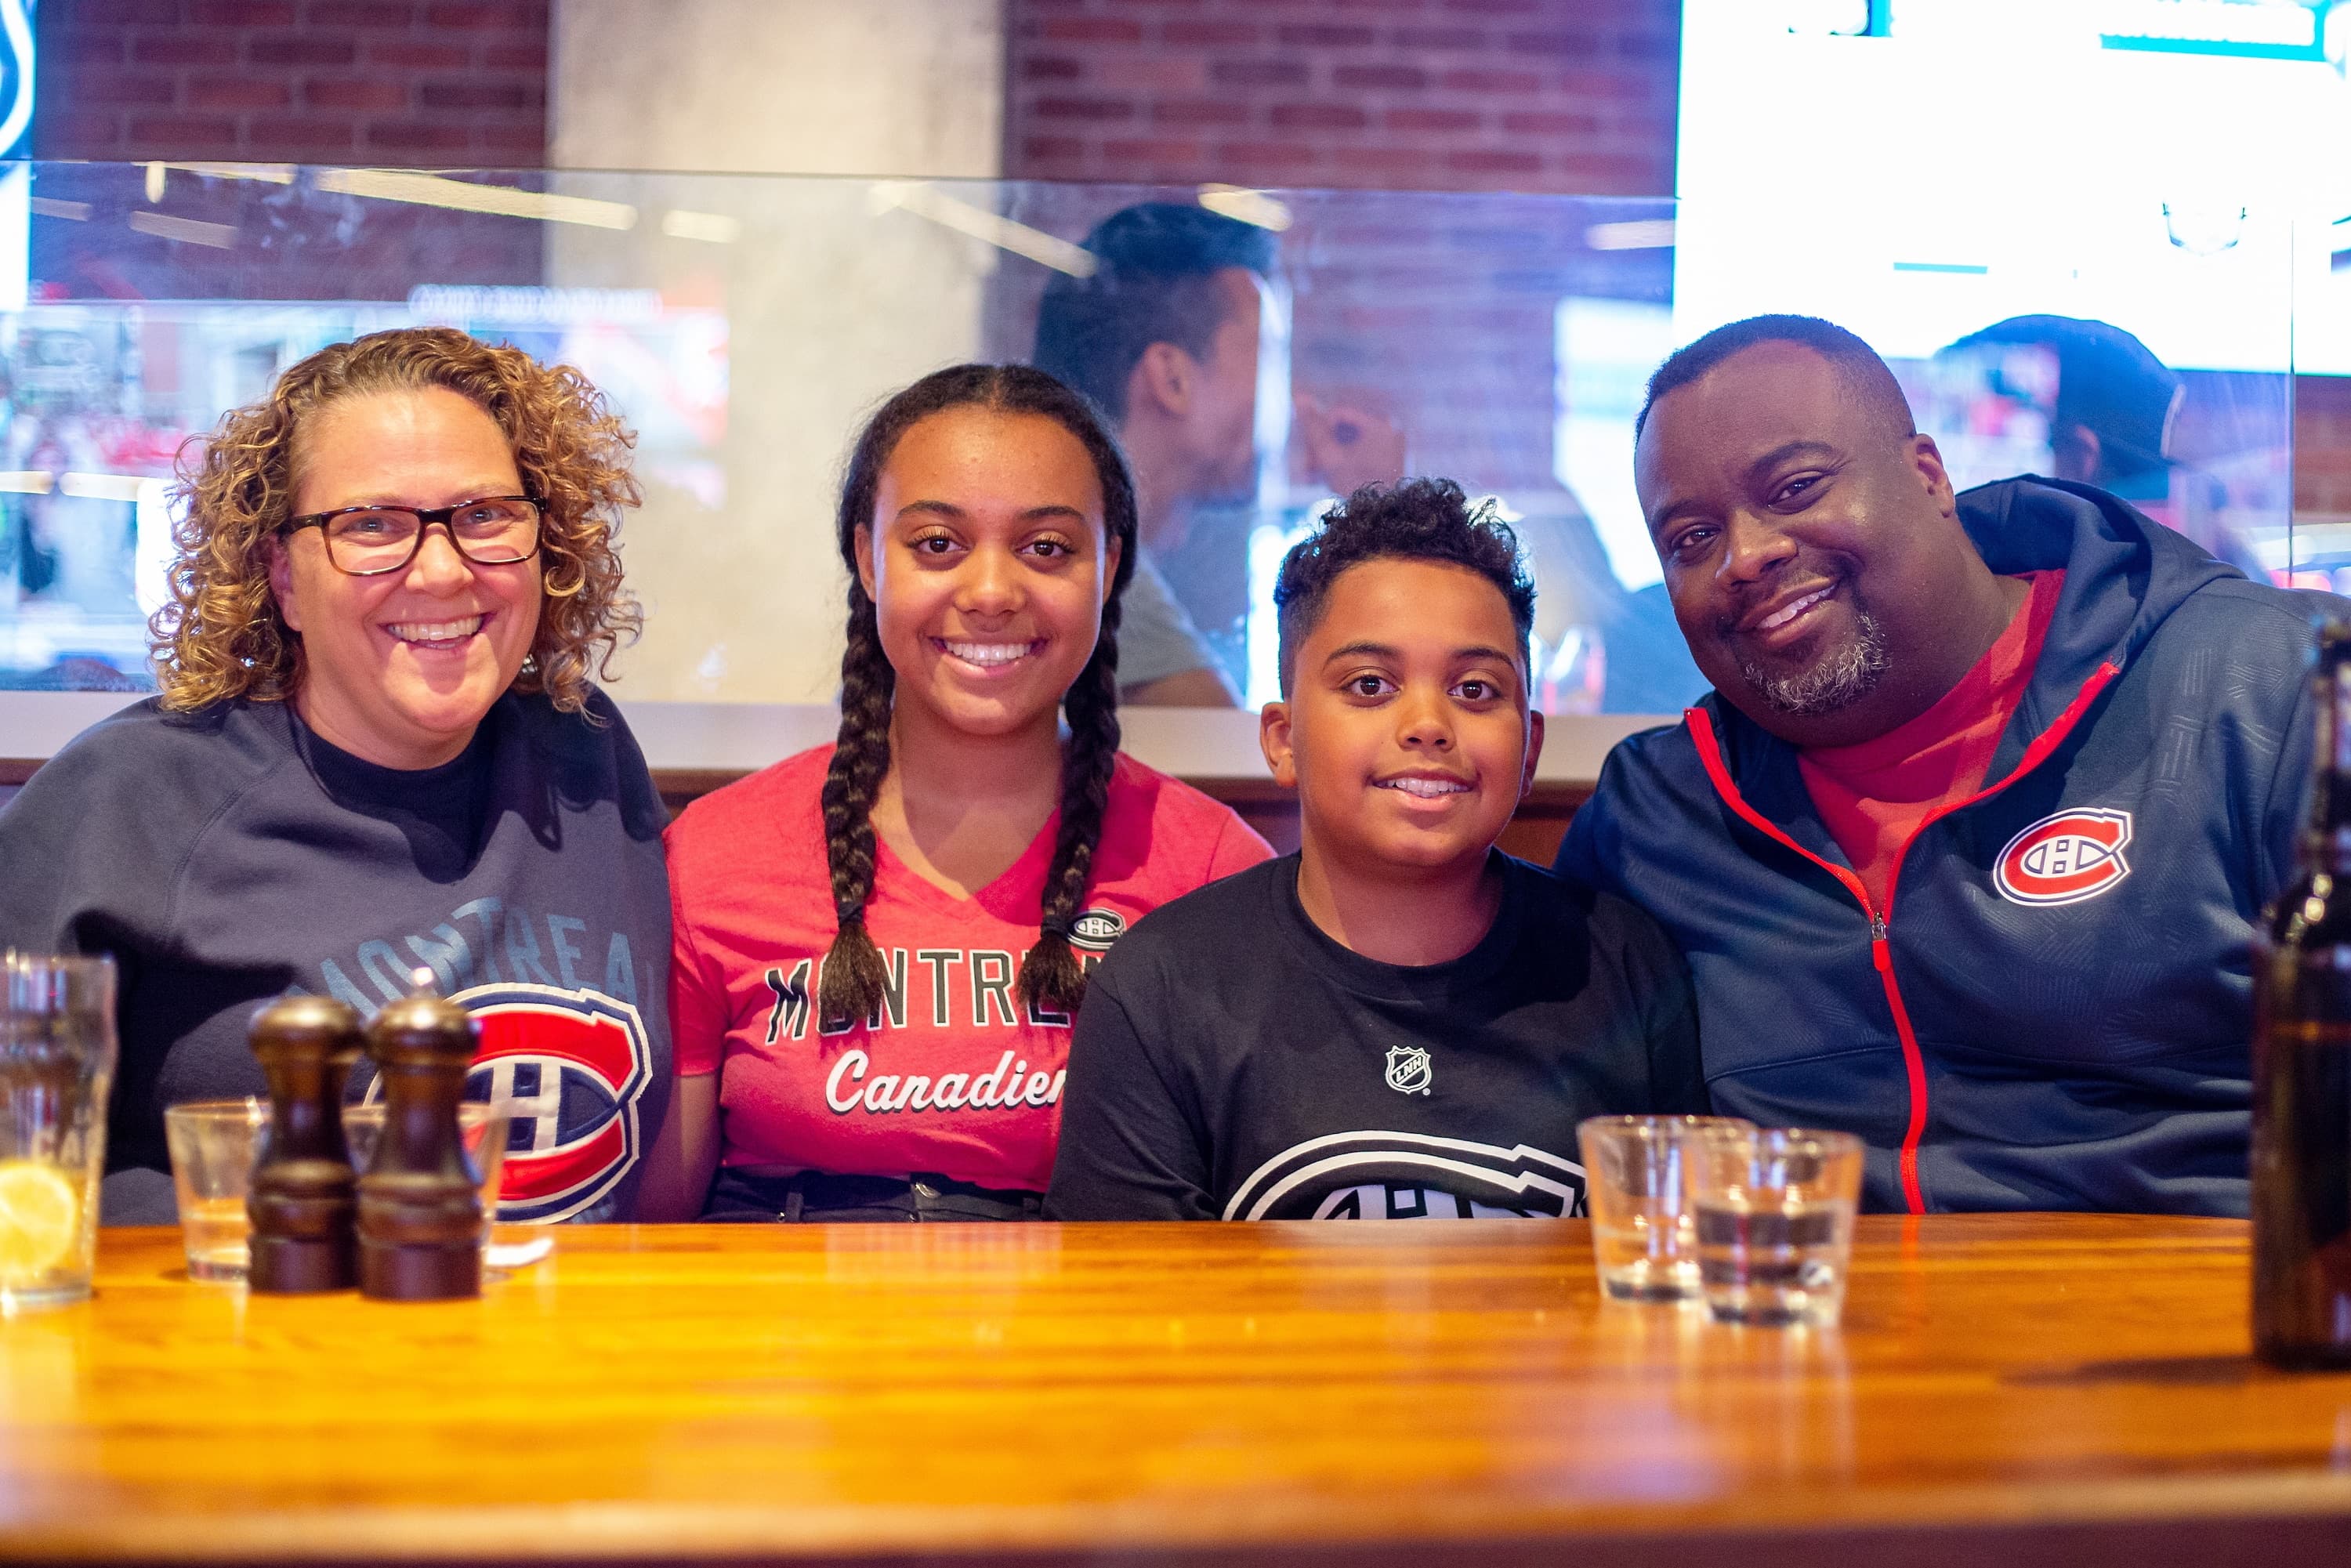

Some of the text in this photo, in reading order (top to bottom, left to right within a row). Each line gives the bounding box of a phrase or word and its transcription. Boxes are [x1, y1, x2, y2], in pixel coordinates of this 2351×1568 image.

[284, 896, 661, 1033] ONTREA
[765, 947, 1102, 1045] MNTR
[1396, 1056, 1422, 1083] LNH
